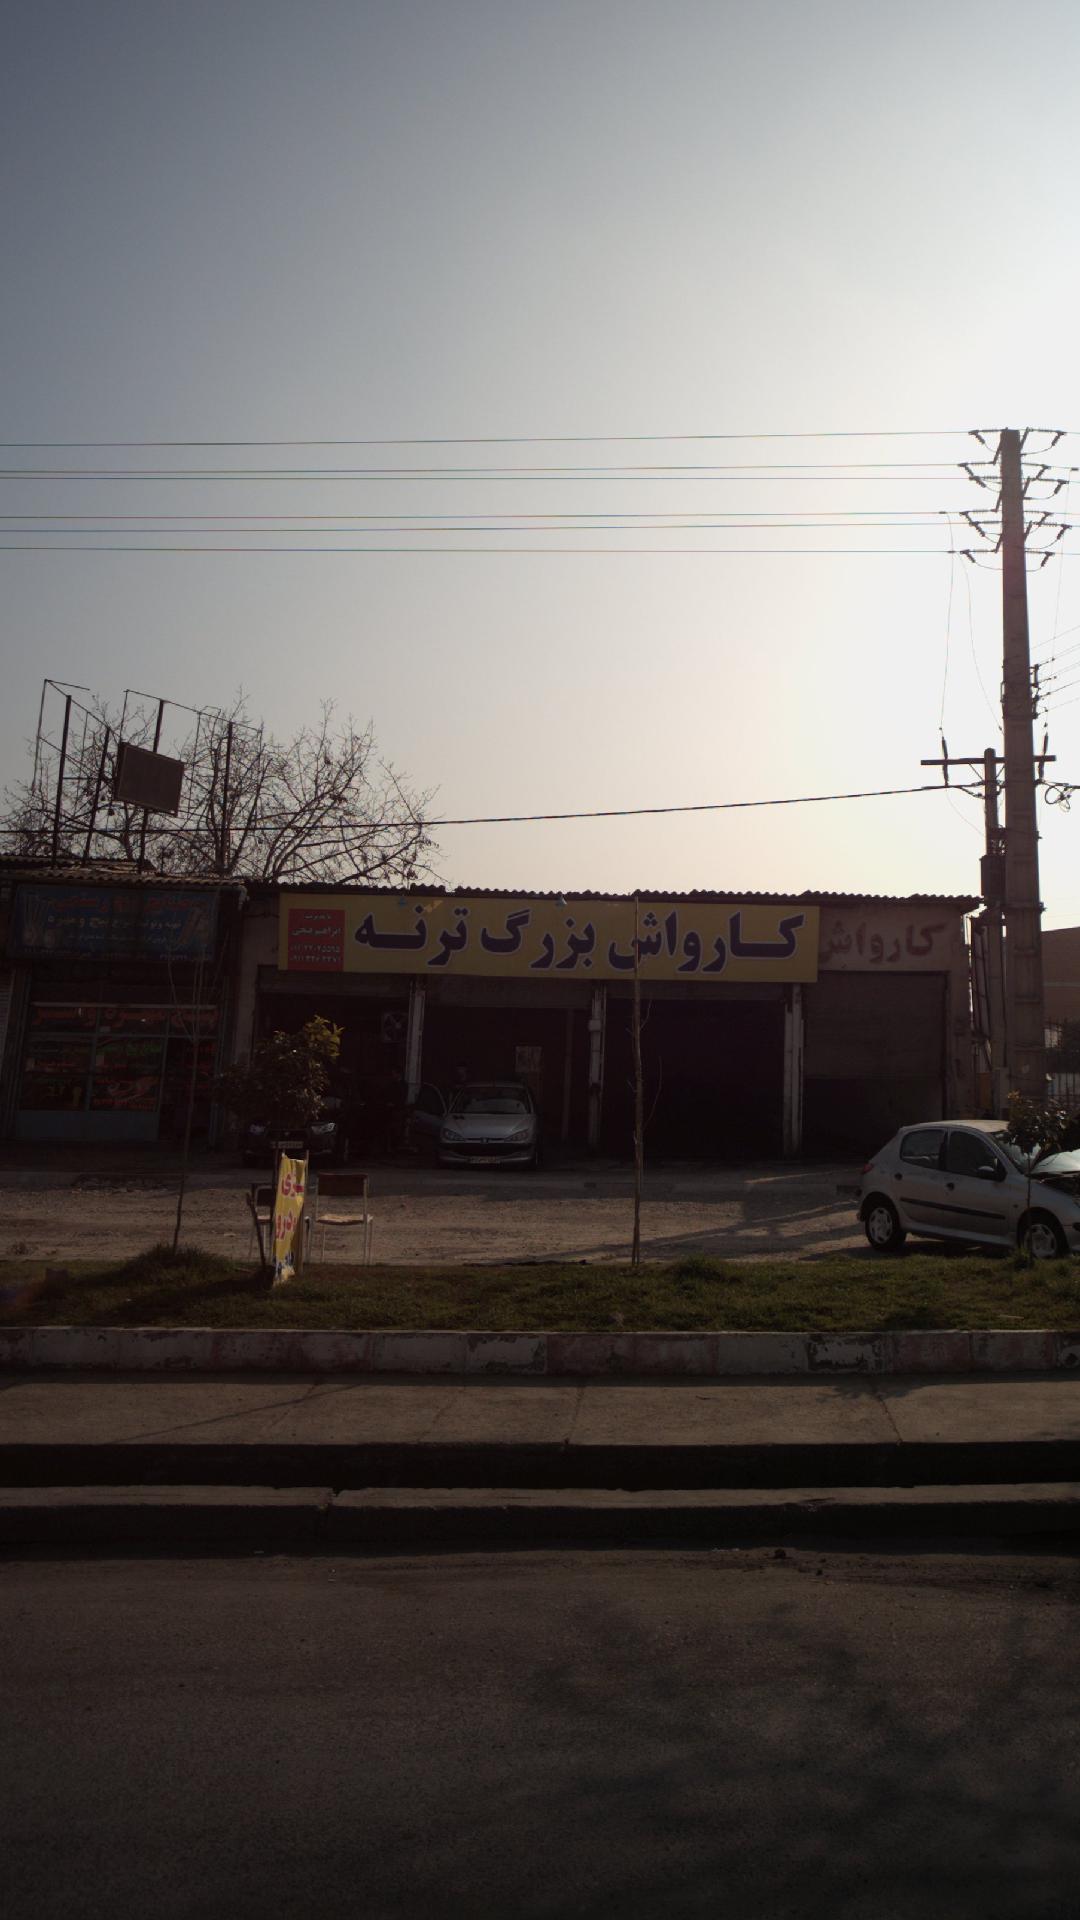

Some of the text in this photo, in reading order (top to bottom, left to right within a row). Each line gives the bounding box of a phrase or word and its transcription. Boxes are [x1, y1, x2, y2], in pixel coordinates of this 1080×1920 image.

[353, 902, 805, 973] کارواش بزرگ ترنه
[819, 919, 948, 964] کارواش
